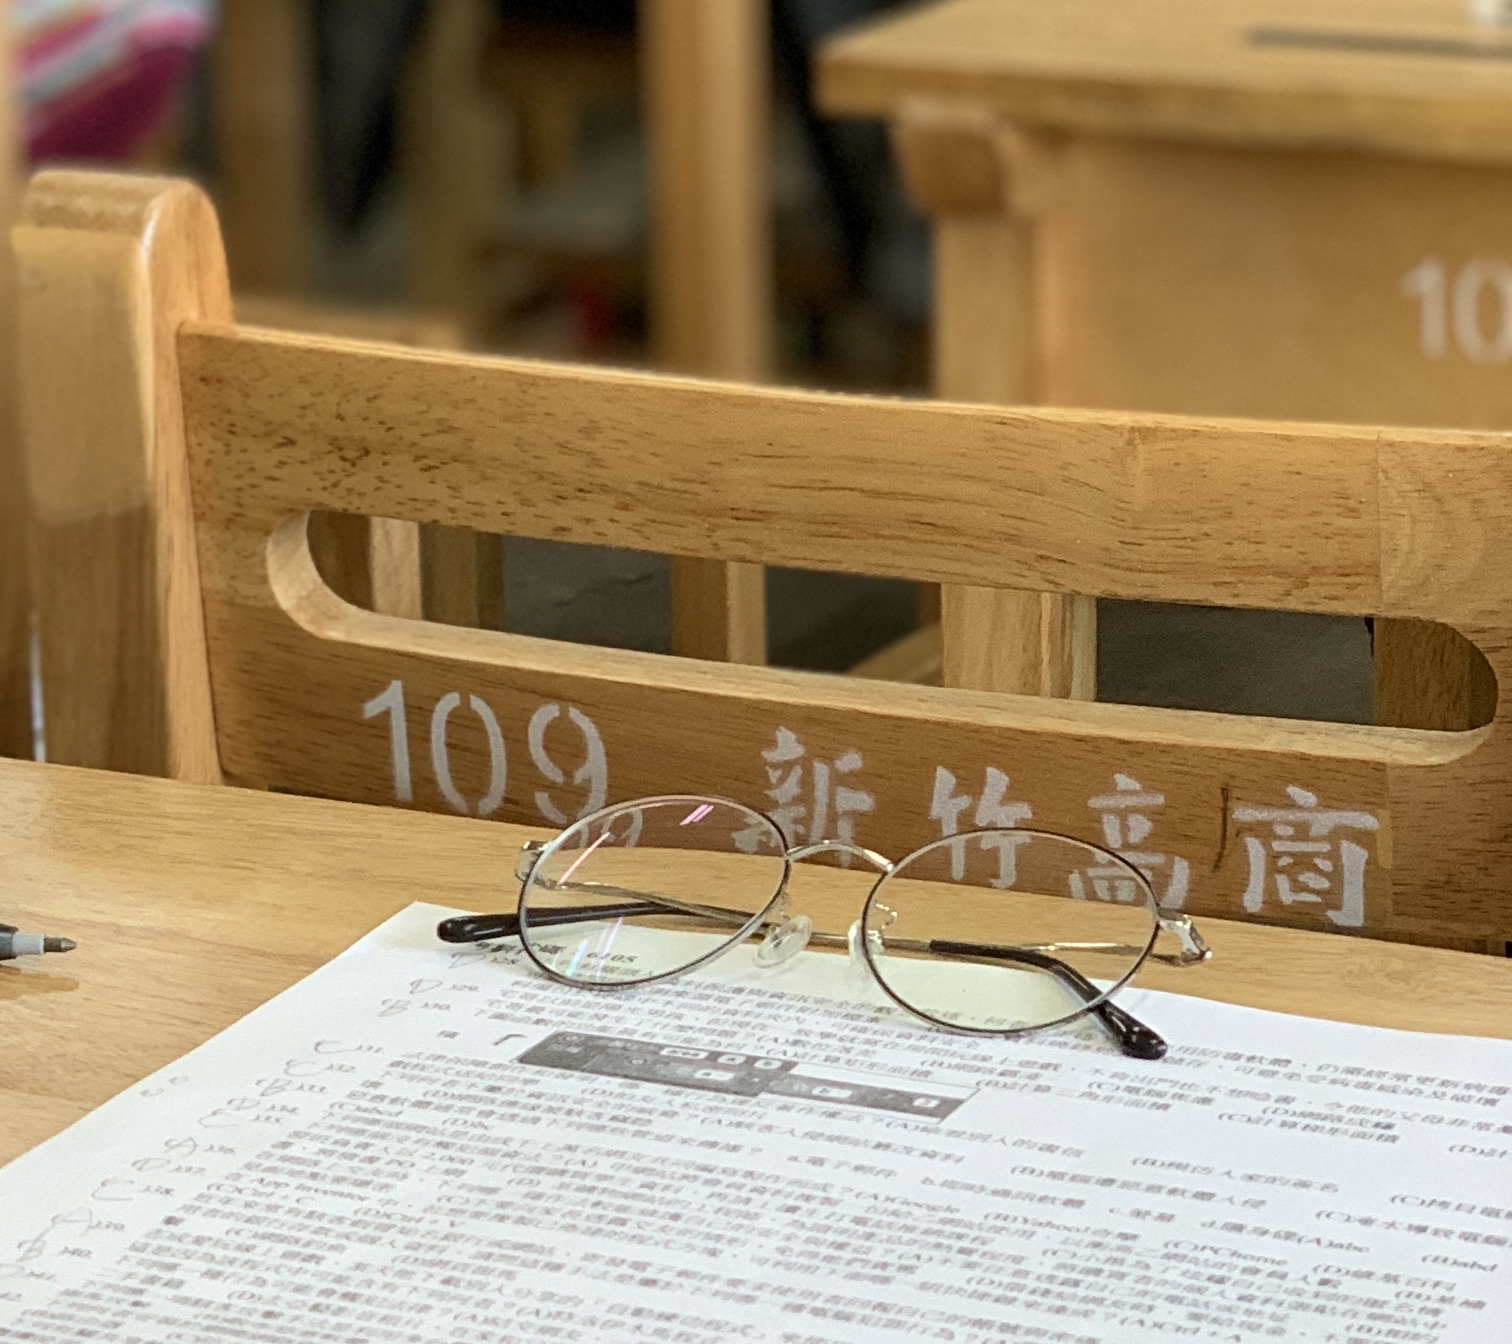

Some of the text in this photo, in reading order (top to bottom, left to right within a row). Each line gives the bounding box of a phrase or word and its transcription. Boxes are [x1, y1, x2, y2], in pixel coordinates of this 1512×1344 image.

[362, 679, 1380, 928] 109 新竹高商
